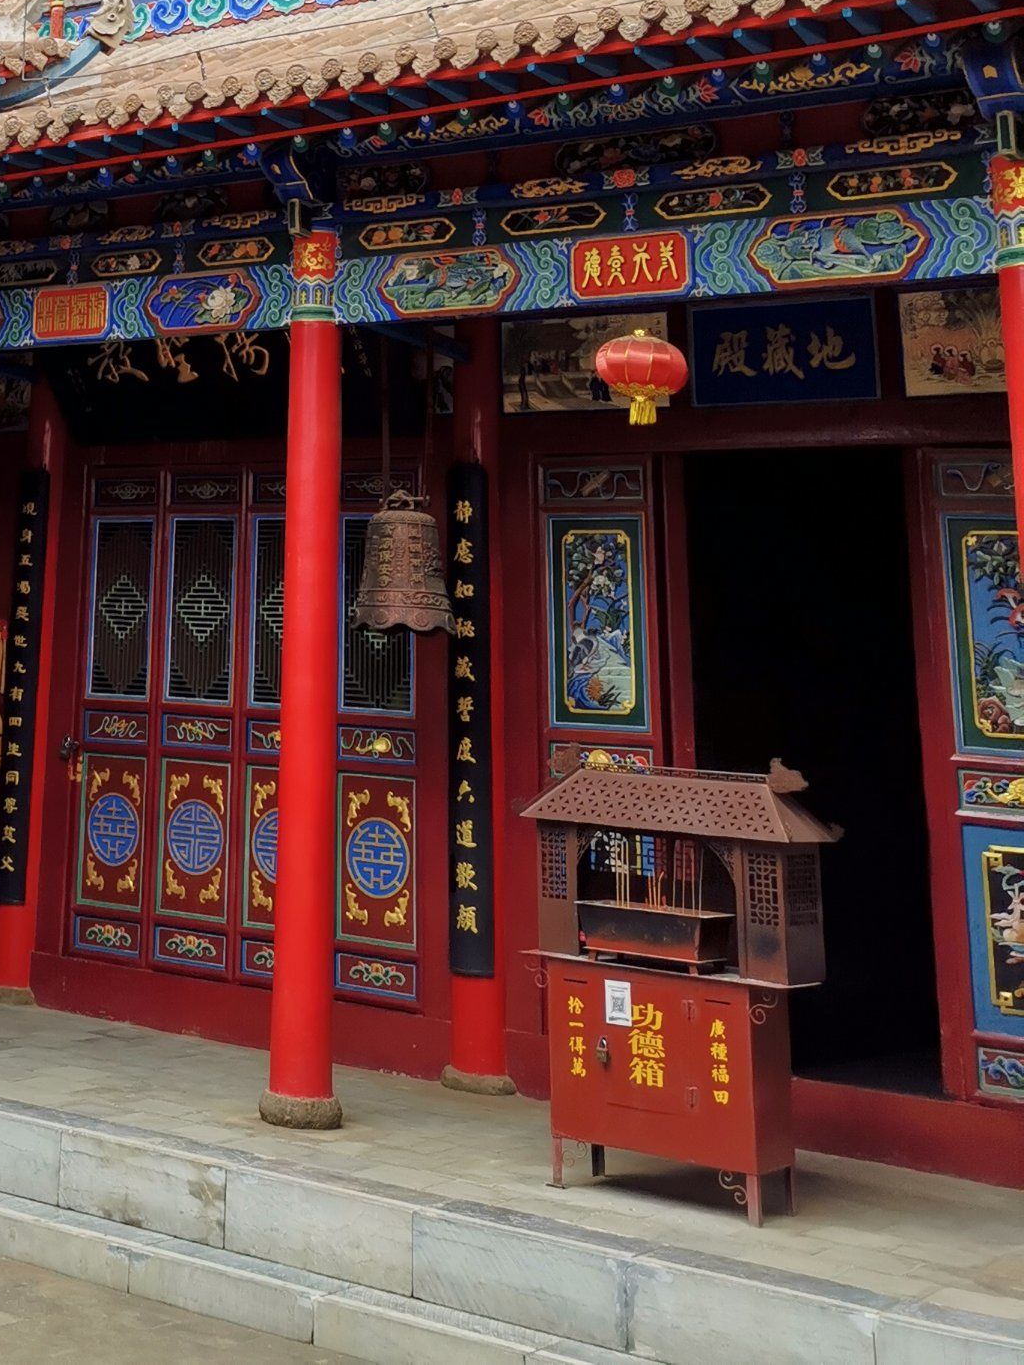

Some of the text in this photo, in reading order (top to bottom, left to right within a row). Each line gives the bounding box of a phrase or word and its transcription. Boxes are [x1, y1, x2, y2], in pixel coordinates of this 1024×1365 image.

[712, 323, 856, 380] 地藏殿
[628, 1003, 665, 1088] 功德箱
[710, 1019, 730, 1105] 廣種福田
